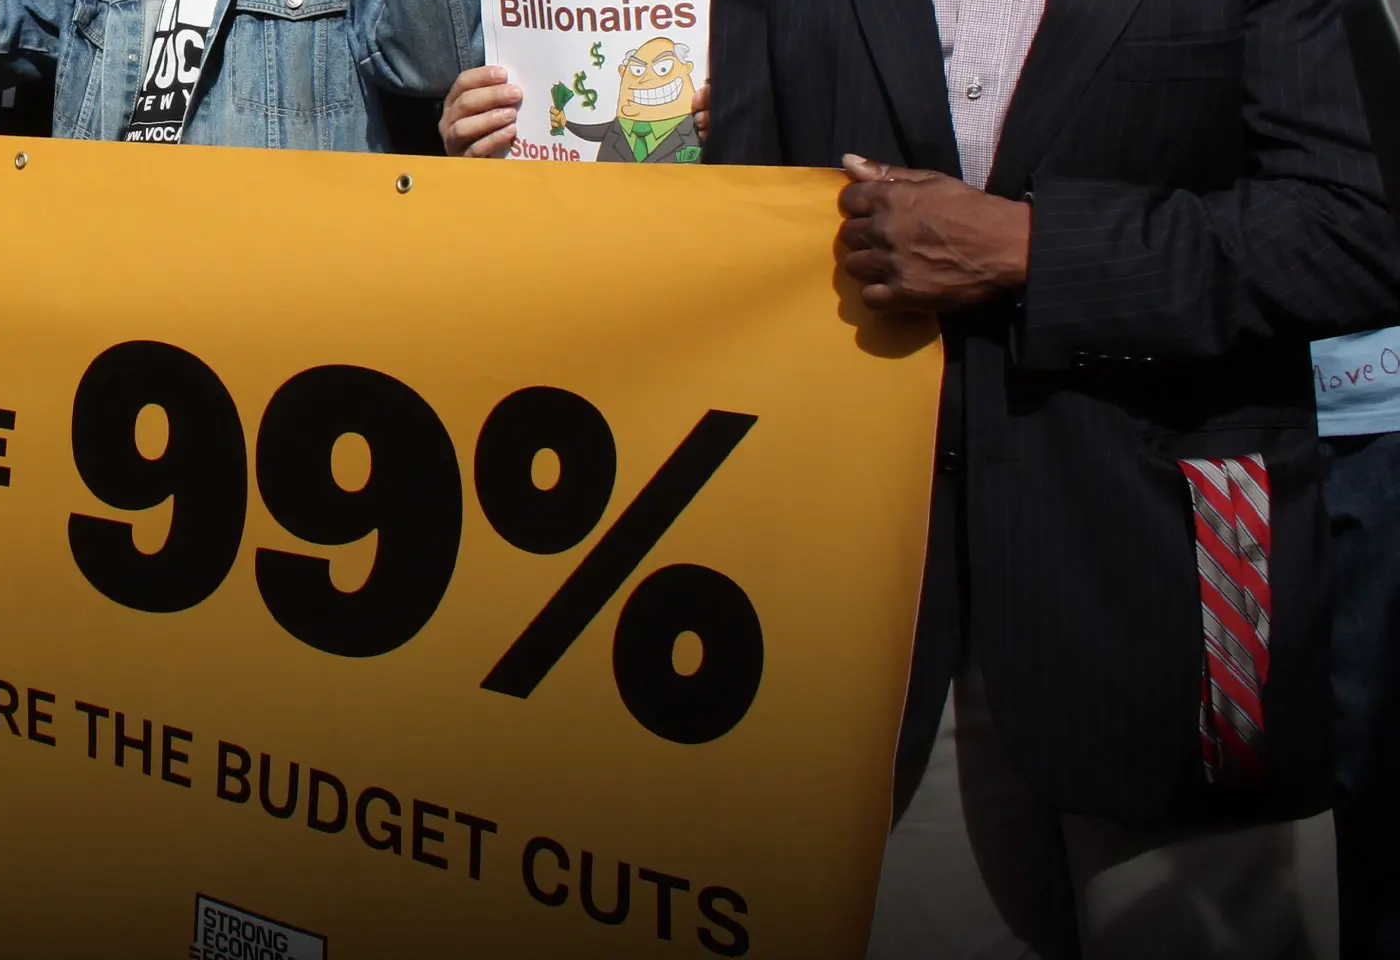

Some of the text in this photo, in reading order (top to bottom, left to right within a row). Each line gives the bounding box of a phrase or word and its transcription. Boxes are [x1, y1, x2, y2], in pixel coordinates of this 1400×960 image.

[552, 143, 580, 162] the
[68, 339, 765, 745] 99%
[75, 700, 194, 788] THE
[216, 740, 498, 881] BUDGET
[521, 835, 750, 958] CUTS
[203, 906, 289, 953] STRONG
